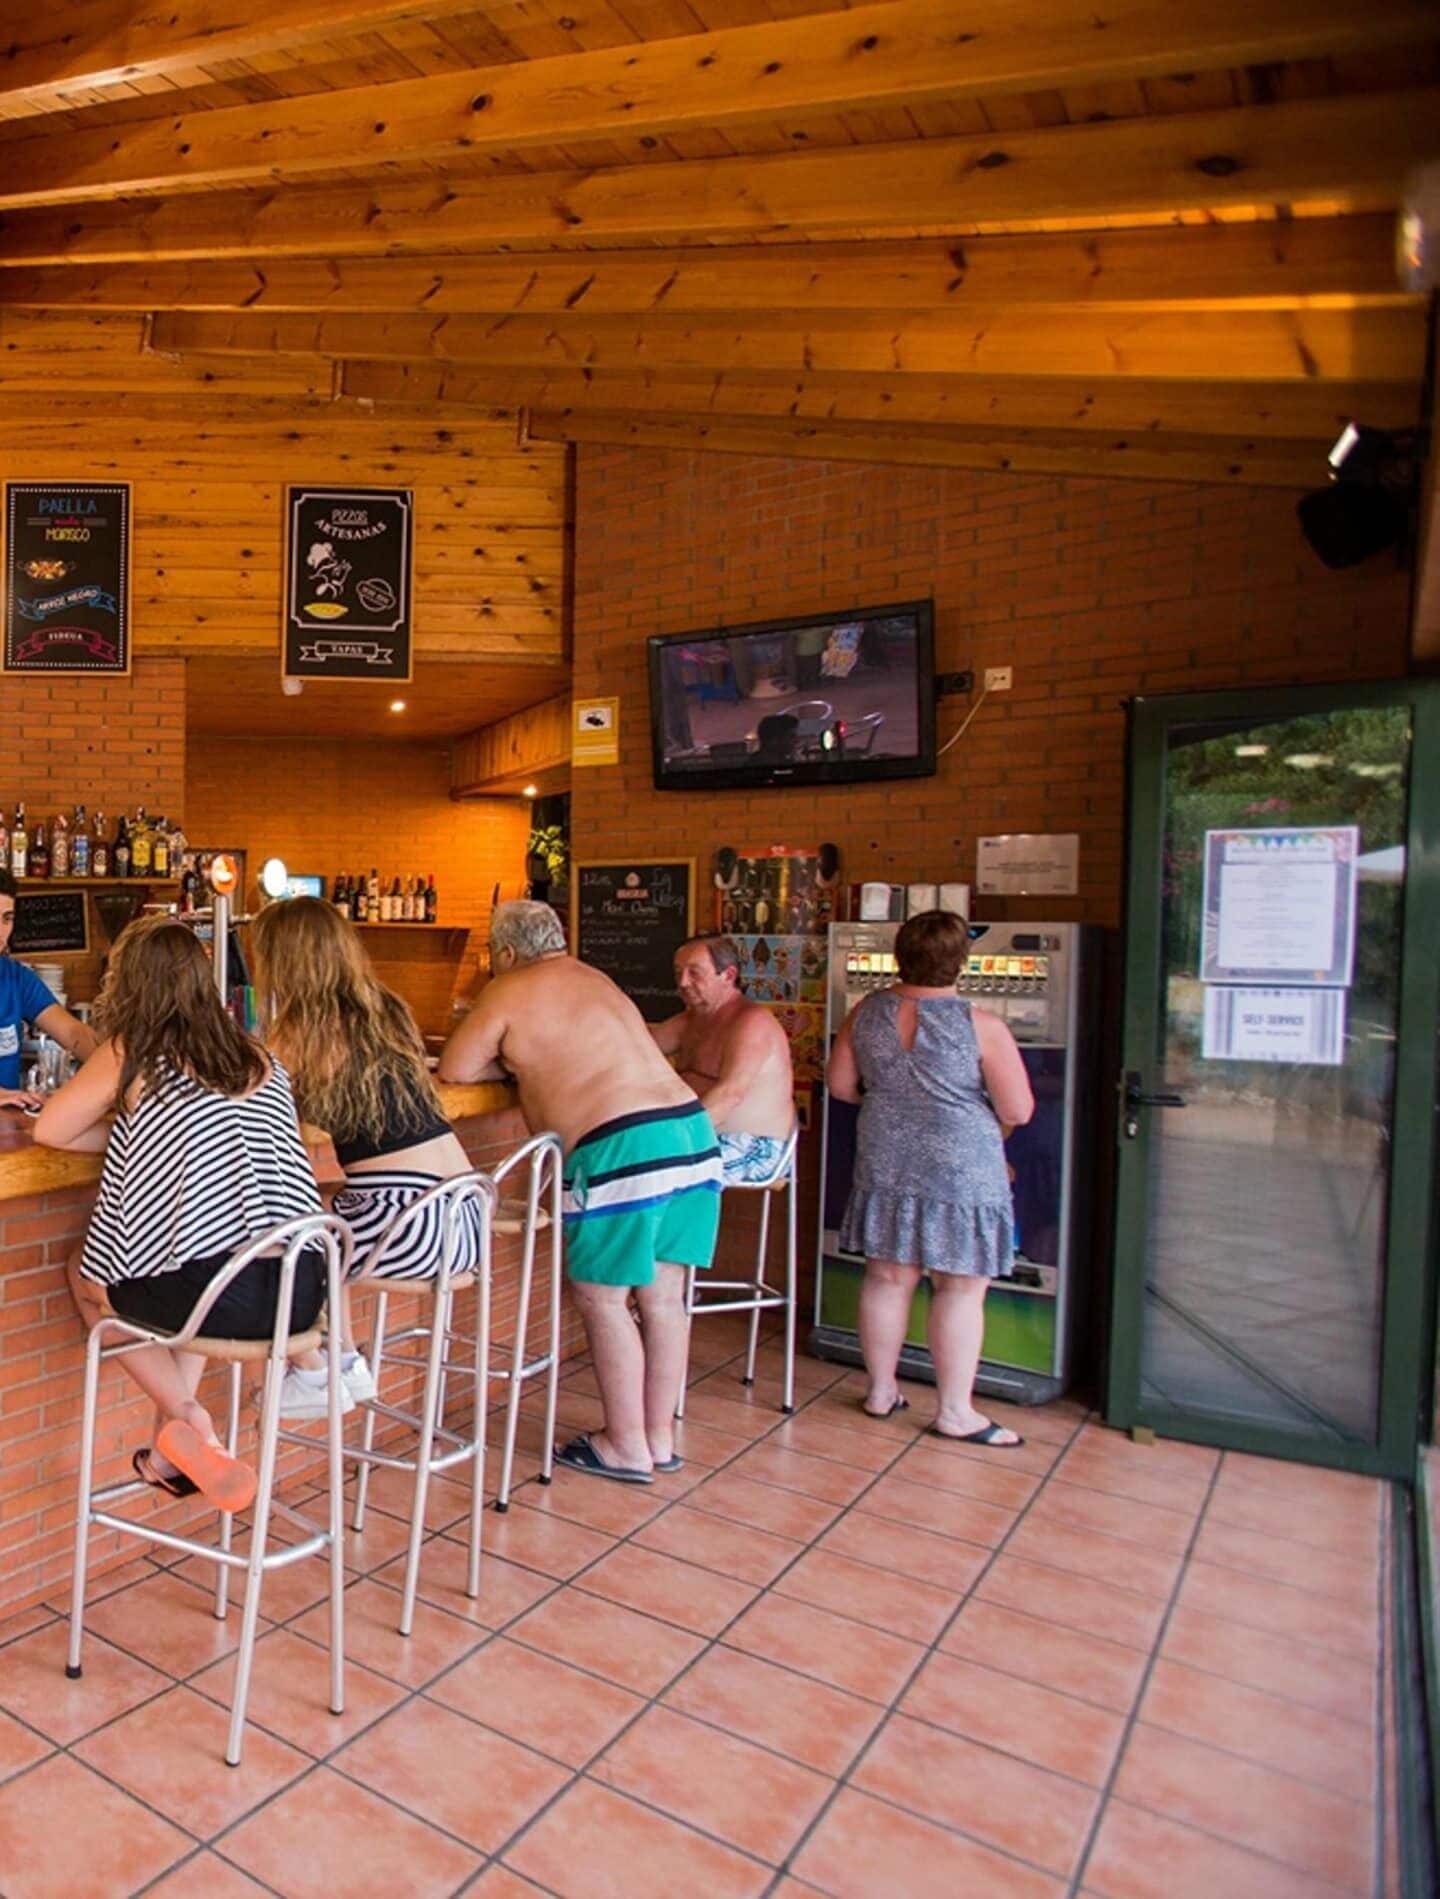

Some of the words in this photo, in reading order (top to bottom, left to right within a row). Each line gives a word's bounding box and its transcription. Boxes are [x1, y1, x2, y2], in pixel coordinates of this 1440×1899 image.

[39, 499, 97, 514] PAELLA
[314, 519, 387, 540] ARTESANAS
[1268, 1014, 1305, 1027] SERVICE
